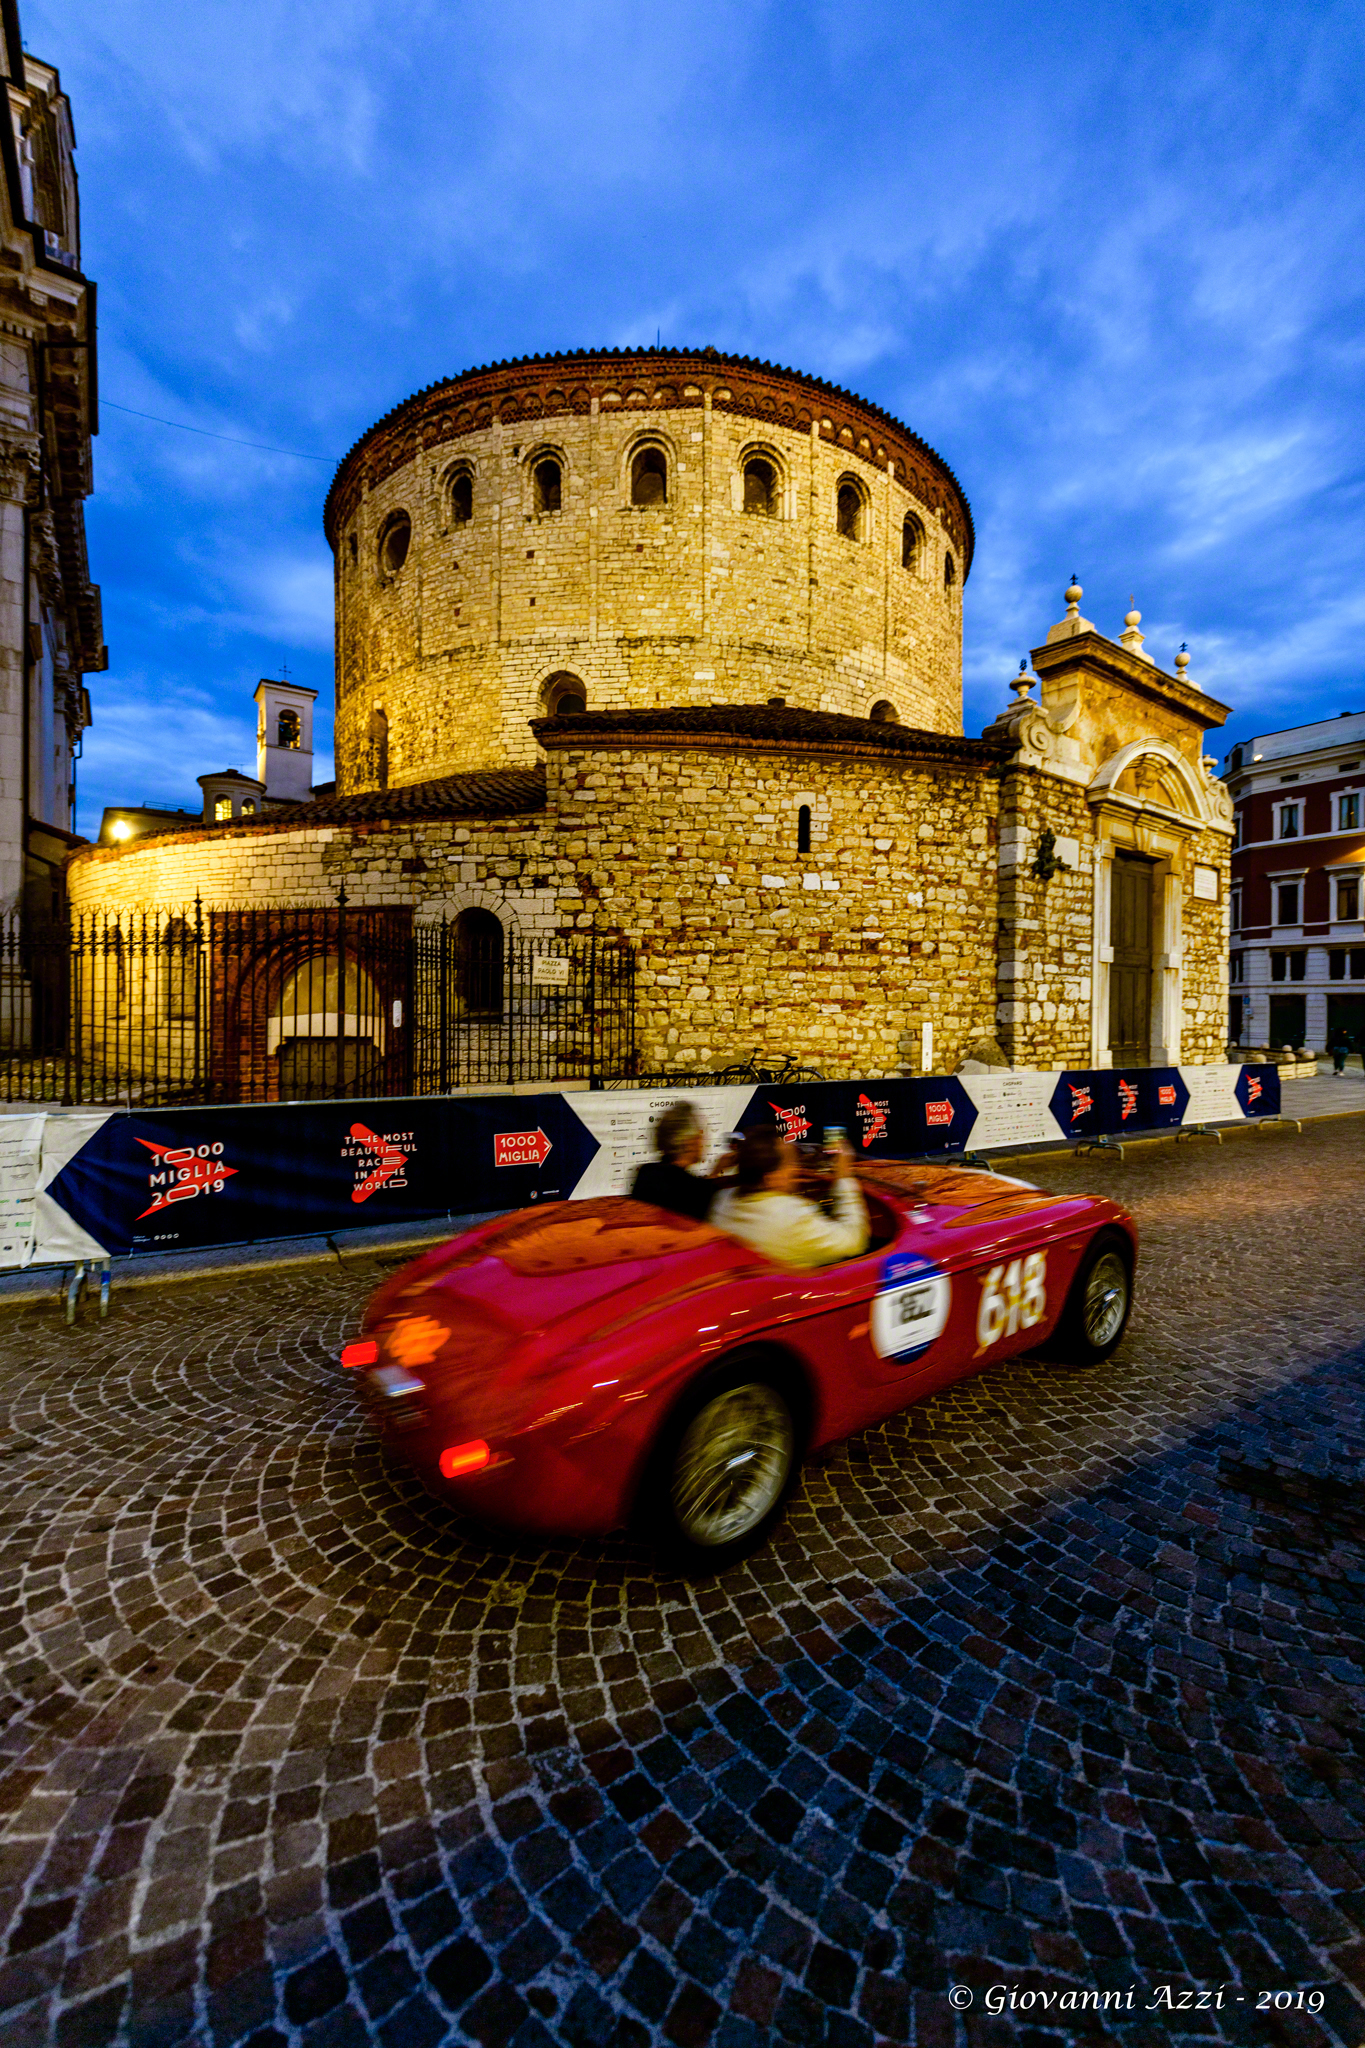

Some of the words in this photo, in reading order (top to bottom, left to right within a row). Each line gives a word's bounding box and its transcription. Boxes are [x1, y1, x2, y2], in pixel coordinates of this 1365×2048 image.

[775, 1105, 806, 1121] 1000
[856, 1108, 891, 1116] BEAUTIFUL
[928, 1104, 947, 1113] 1000
[864, 1116, 884, 1124] RACE
[928, 1114, 949, 1122] MIGLIA
[776, 1117, 807, 1133] MIGLIA
[345, 1134, 378, 1146] THE
[383, 1132, 414, 1142] MOST
[500, 1135, 536, 1148] 1000
[778, 1129, 808, 1144] 019
[862, 1132, 888, 1140] WORLD
[151, 1142, 225, 1168] 1000
[341, 1144, 417, 1157] BEAUTIFUL
[498, 1150, 540, 1163] MIGLIA
[358, 1156, 401, 1168] RACE
[149, 1160, 226, 1188] MIGLIA
[355, 1170, 368, 1180] IN
[372, 1167, 405, 1179] THE
[354, 1179, 408, 1191] WORLD
[151, 1179, 225, 1207] 2019
[976, 1251, 1047, 1348] 618
